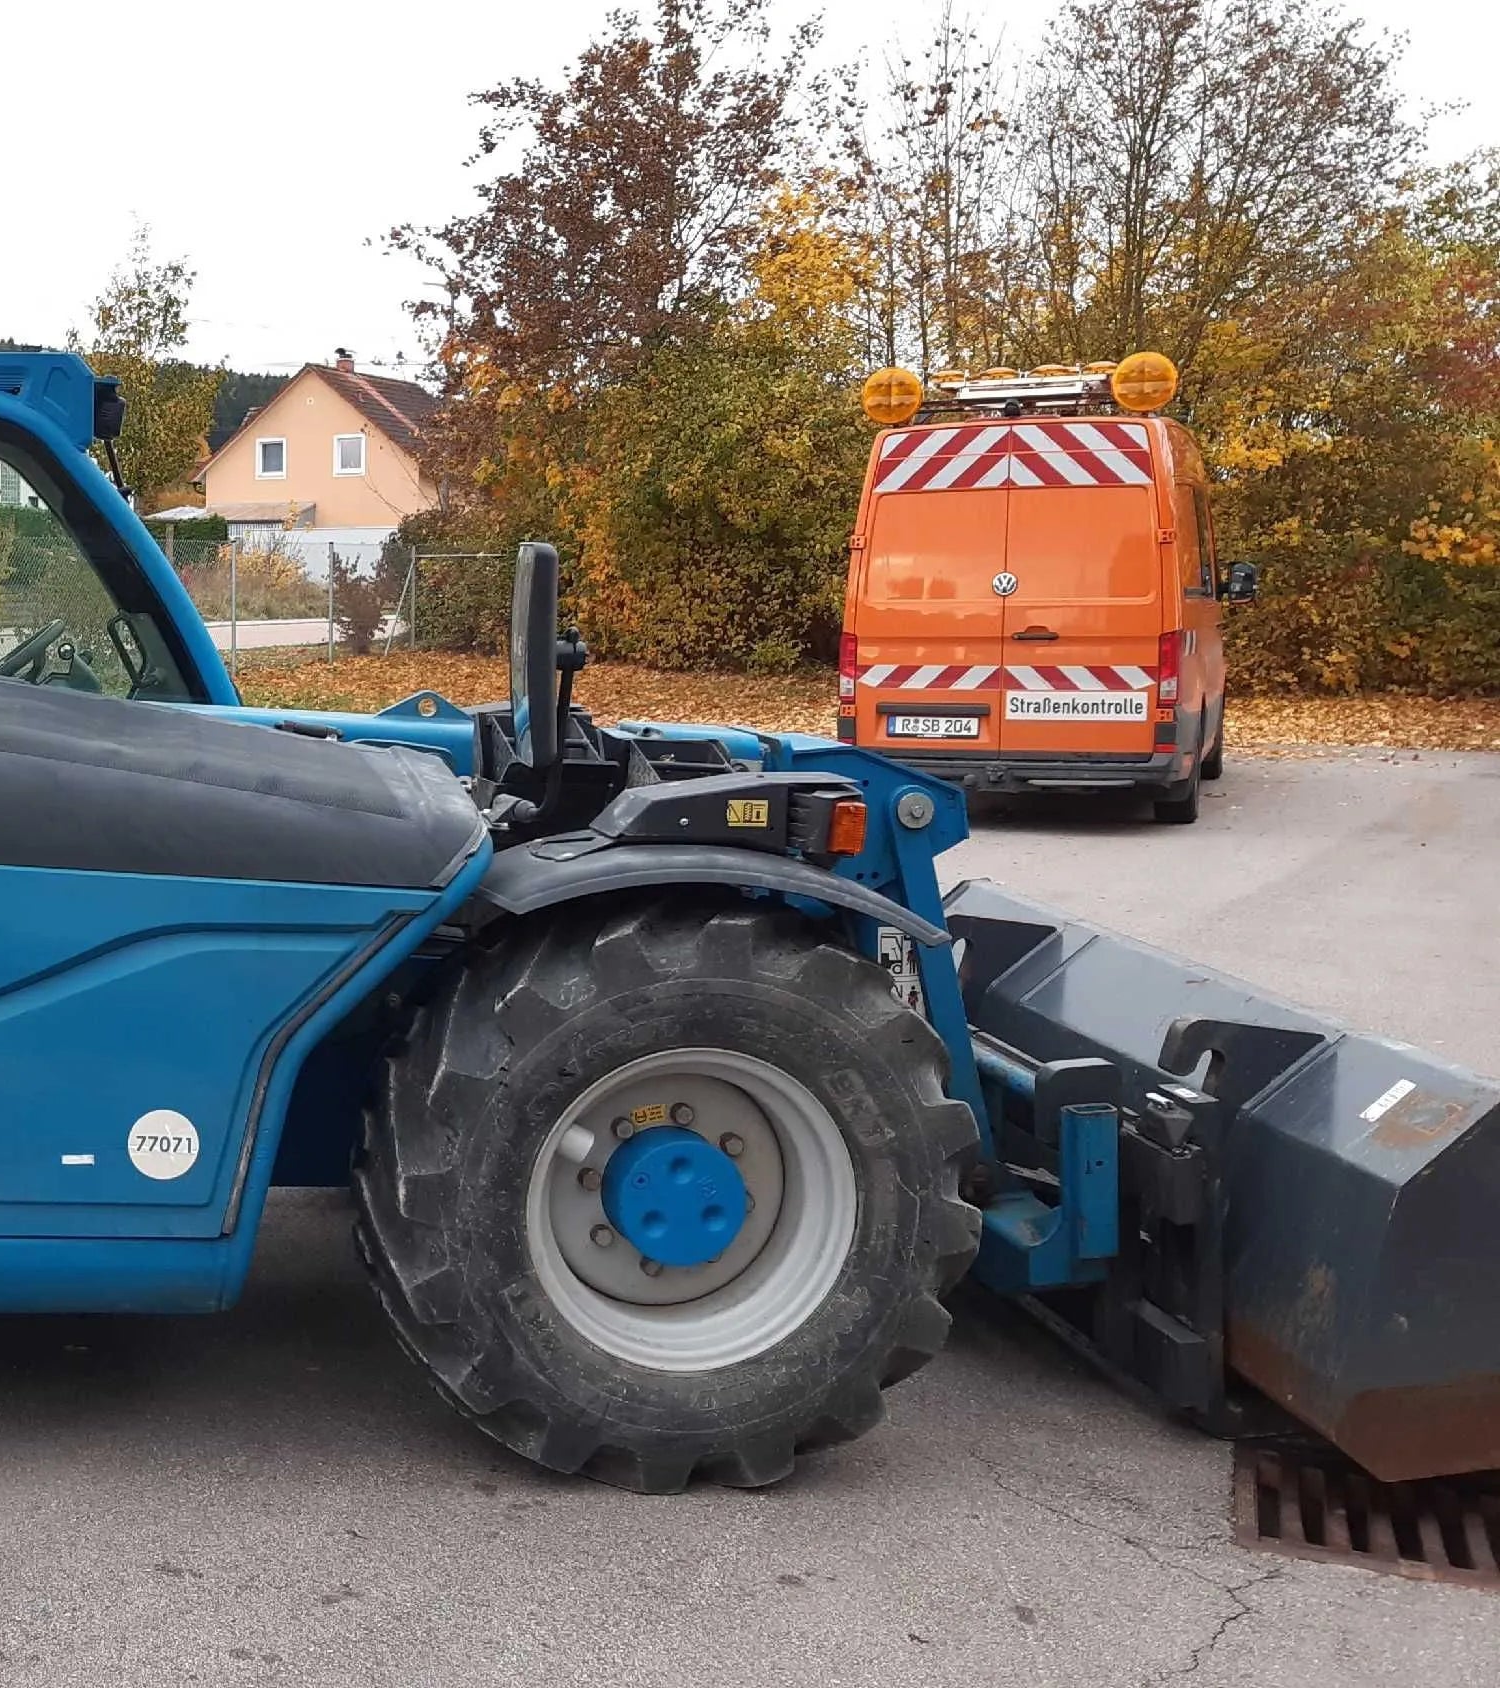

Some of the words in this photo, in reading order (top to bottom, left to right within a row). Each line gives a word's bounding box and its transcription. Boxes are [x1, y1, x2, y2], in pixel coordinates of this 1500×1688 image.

[1009, 696, 1144, 716] Straßenkontrolle
[901, 718, 912, 732] R
[921, 719, 940, 732] SB
[944, 719, 972, 733] 204
[135, 1135, 192, 1154] 77071
